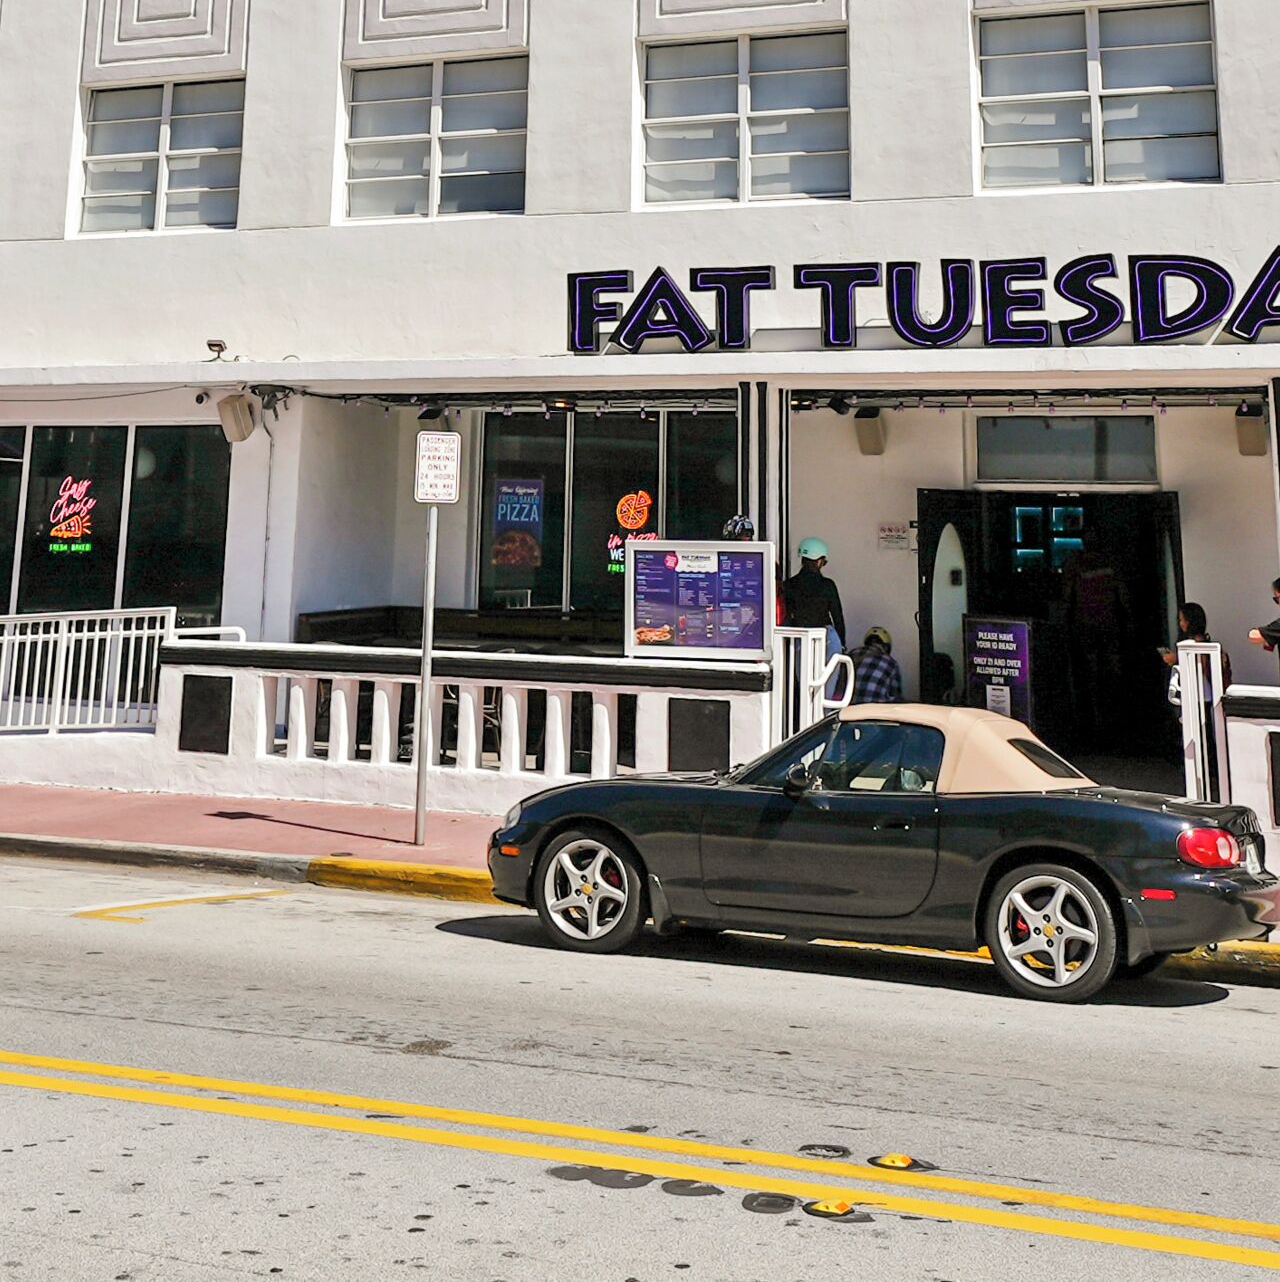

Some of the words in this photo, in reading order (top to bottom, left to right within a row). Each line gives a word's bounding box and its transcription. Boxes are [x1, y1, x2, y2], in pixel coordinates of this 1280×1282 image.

[566, 265, 776, 355] FAT
[421, 454, 456, 462] PARKING
[427, 463, 448, 471] ONLY
[50, 497, 98, 523] Cheese
[498, 503, 539, 522] PIZZA
[610, 548, 625, 561] WE
[978, 632, 998, 640] PLEASE
[999, 633, 1014, 641] HAVE
[976, 641, 991, 649] YOUR
[999, 642, 1016, 650] READY
[973, 657, 987, 665] ONLY
[994, 658, 1006, 667] AND
[1007, 660, 1021, 668] OVER
